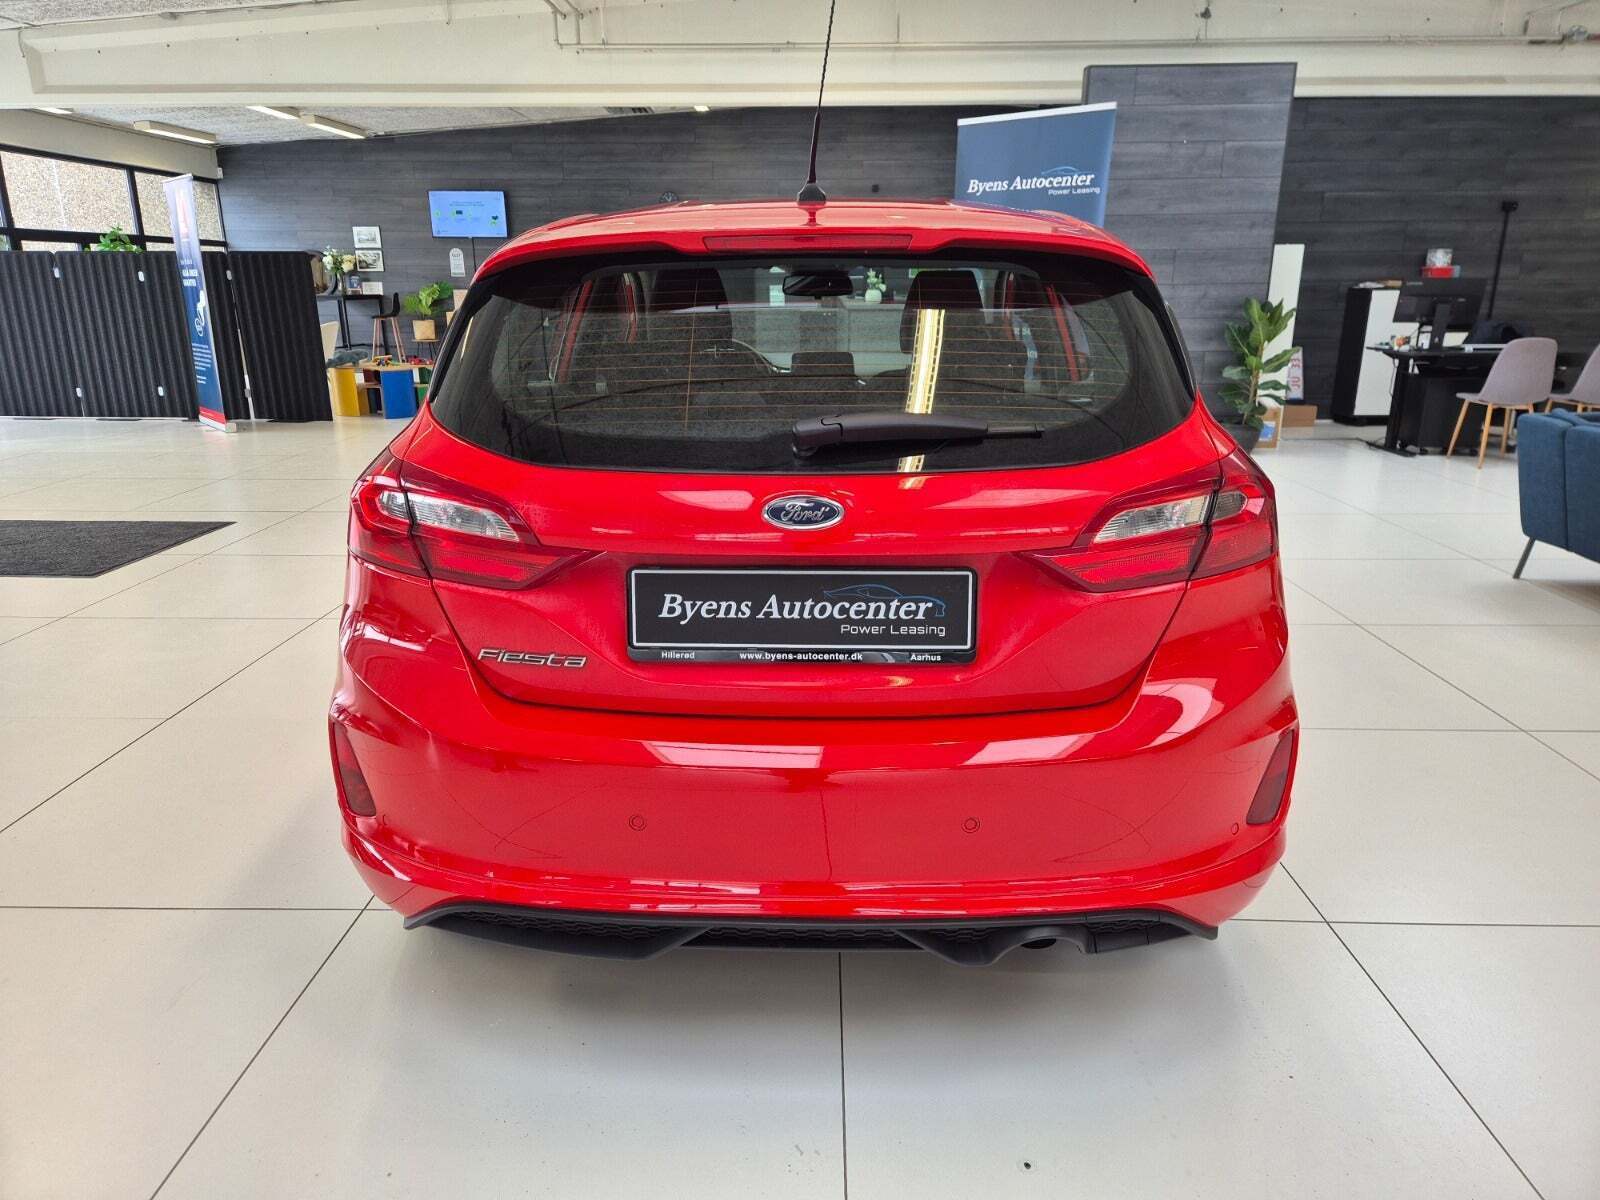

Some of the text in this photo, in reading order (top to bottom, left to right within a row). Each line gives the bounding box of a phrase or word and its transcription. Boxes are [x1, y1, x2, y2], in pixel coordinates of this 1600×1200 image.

[967, 173, 1095, 196] Byens Autocenter
[1048, 186, 1101, 196] Power Leasing
[780, 501, 830, 522] Ford
[658, 593, 933, 625] Byens Autocenter
[840, 624, 946, 637] Power Leasing
[477, 648, 587, 668] Fiesta
[739, 651, 863, 662] www.byens-autocenter.dk
[910, 653, 942, 662] Aarhus
